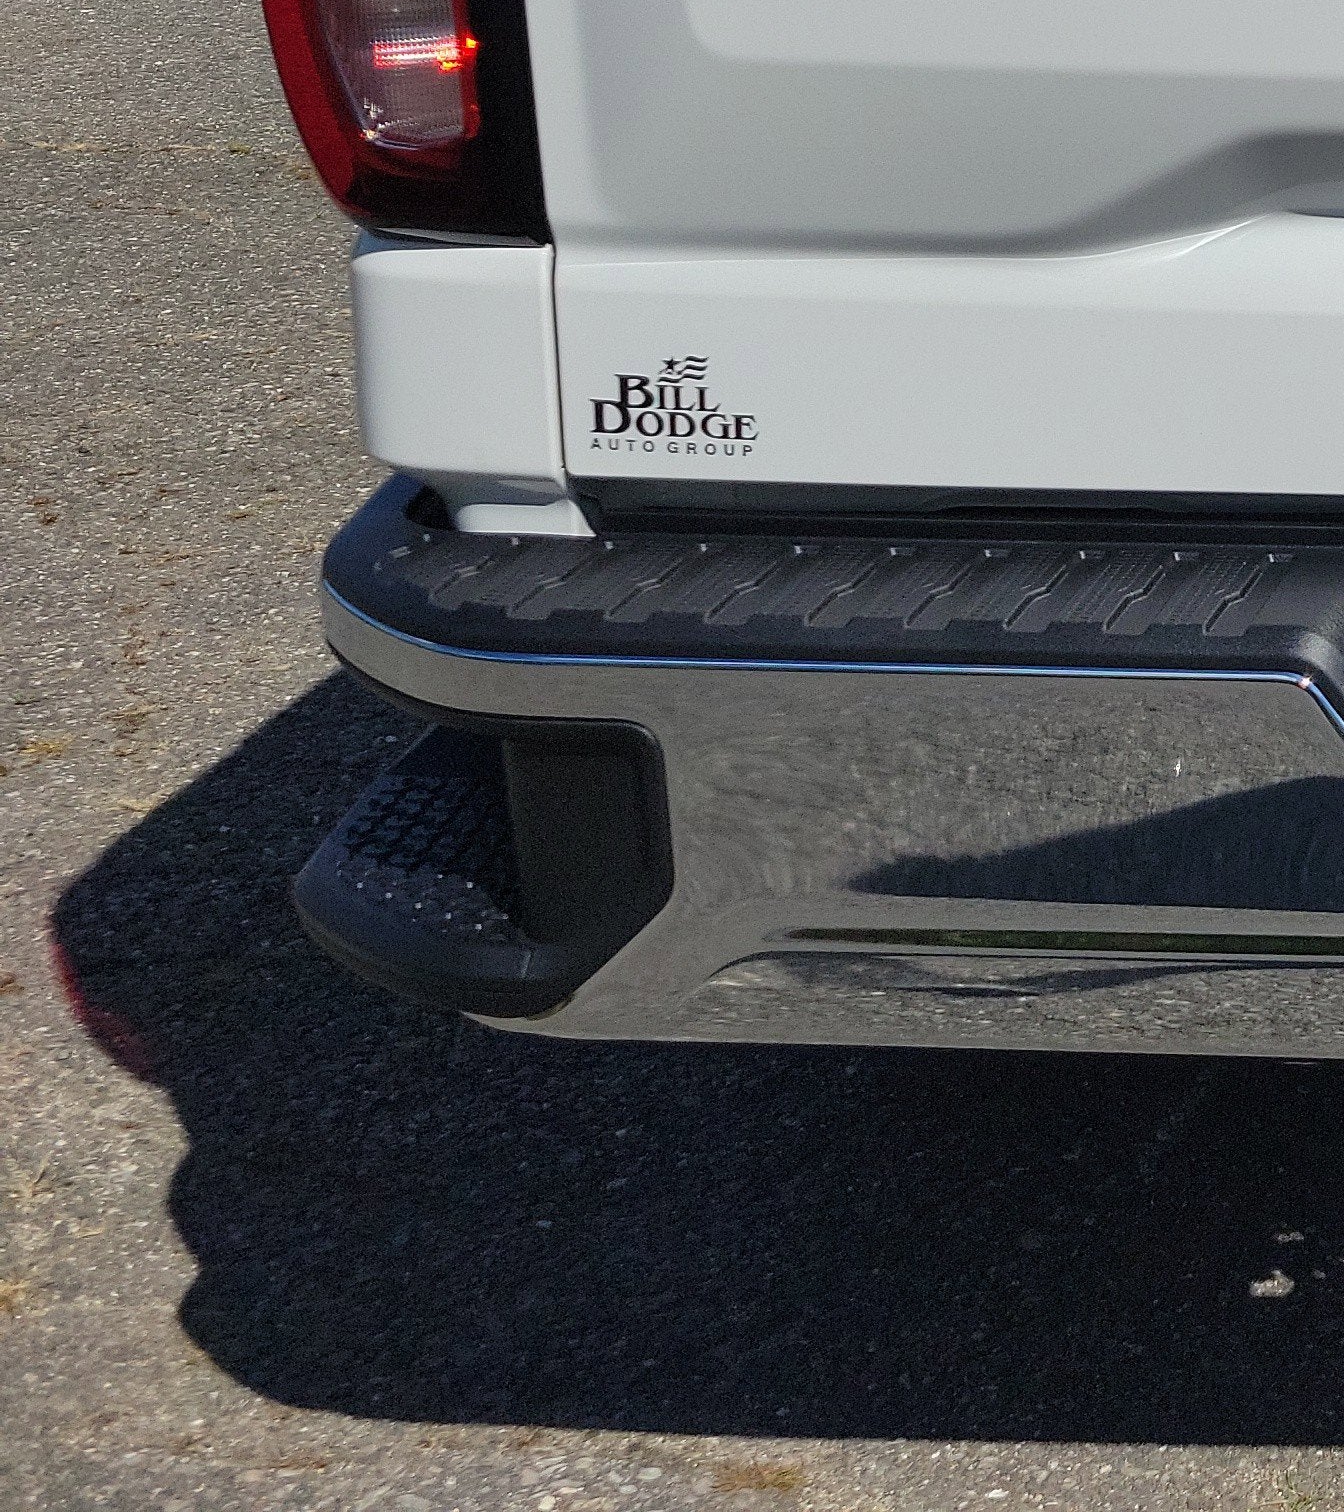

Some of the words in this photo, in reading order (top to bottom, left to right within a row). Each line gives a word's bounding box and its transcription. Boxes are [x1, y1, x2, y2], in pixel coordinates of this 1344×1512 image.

[614, 373, 722, 412] BILL
[589, 398, 760, 441] DODGE
[590, 438, 655, 453] AUTO
[667, 441, 753, 457] GROUP
